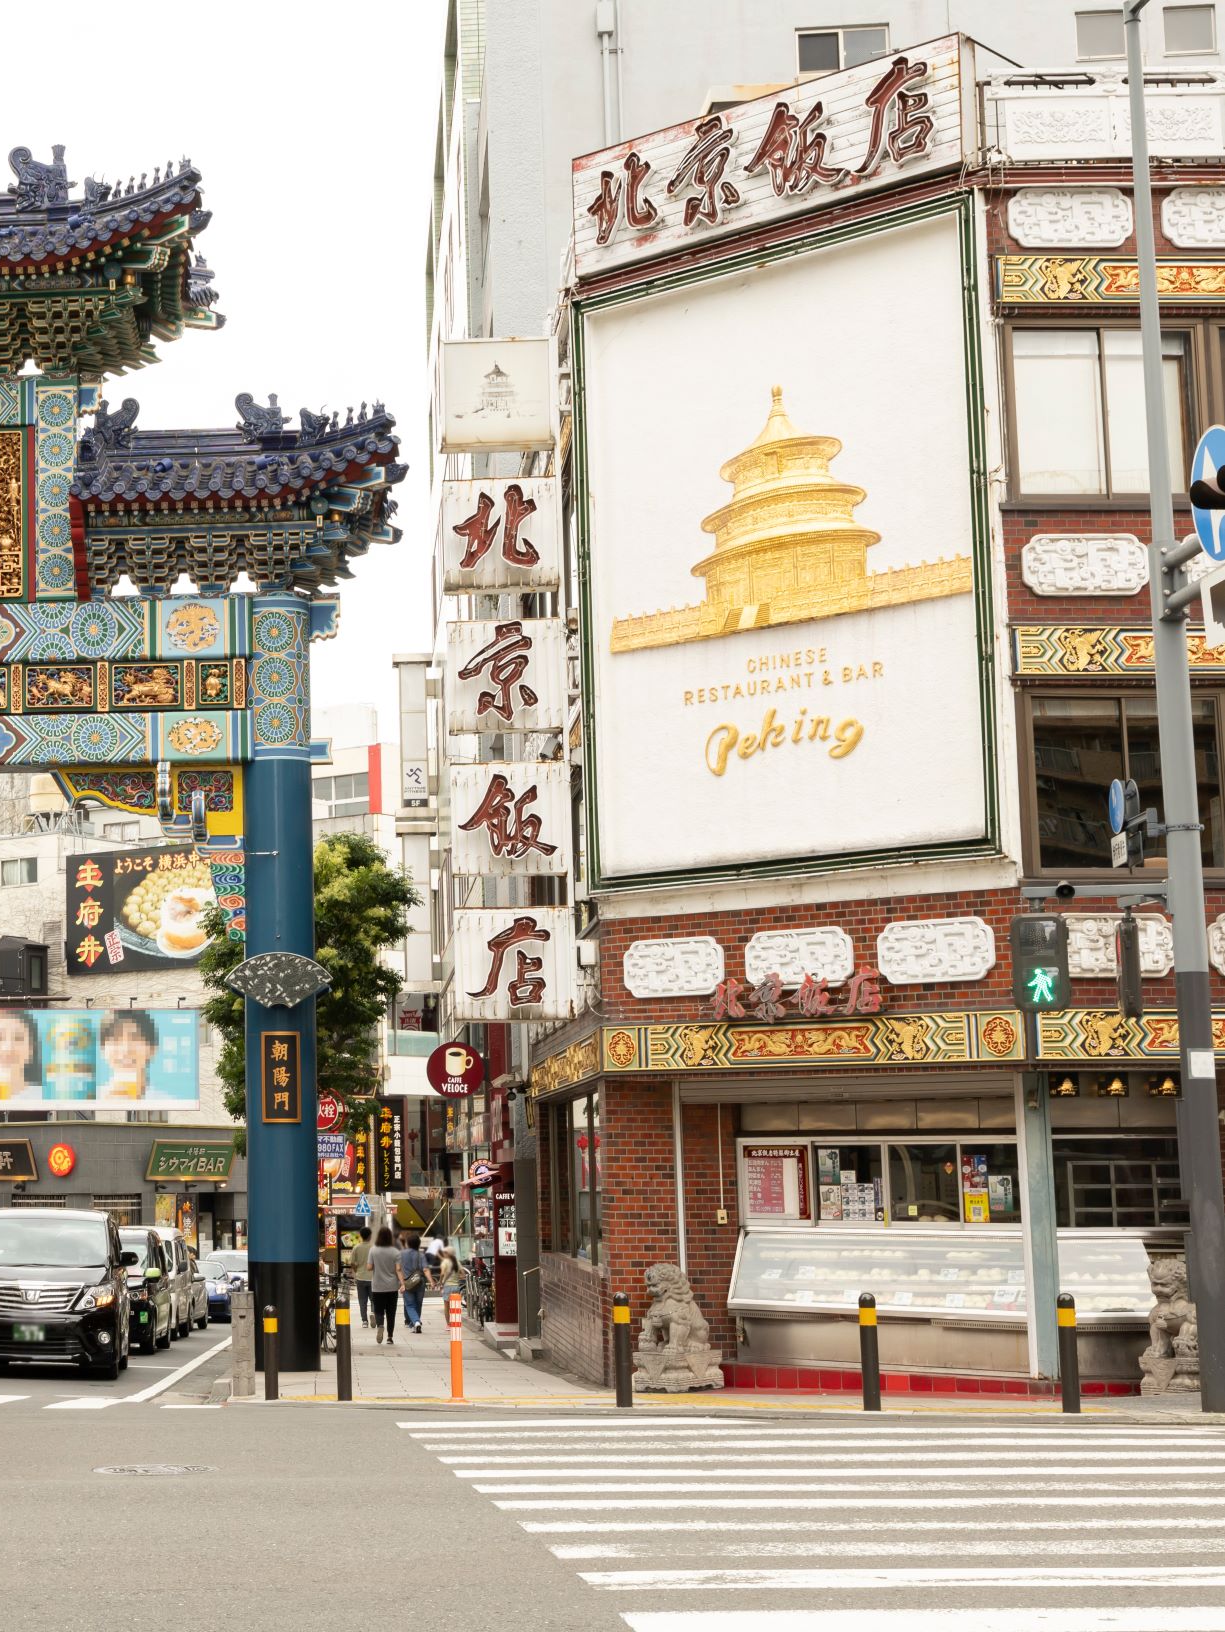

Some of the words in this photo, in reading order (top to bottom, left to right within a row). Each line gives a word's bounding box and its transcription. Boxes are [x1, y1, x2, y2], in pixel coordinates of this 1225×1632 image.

[587, 56, 936, 246] 北京飯店
[684, 672, 816, 706] RESTAURANT
[822, 669, 833, 686] &
[842, 661, 884, 684] BAR
[747, 648, 828, 674] CHINESE
[705, 707, 865, 776] Peking
[114, 856, 154, 874] ようこそ
[76, 862, 103, 964] 王府井
[710, 965, 882, 1024] 北京飯店
[271, 1040, 290, 1112] 朝陽門
[441, 1083, 468, 1093] VELOCE
[159, 1156, 225, 1172] シウマイBAR
[317, 1144, 343, 1152] 980FAX
